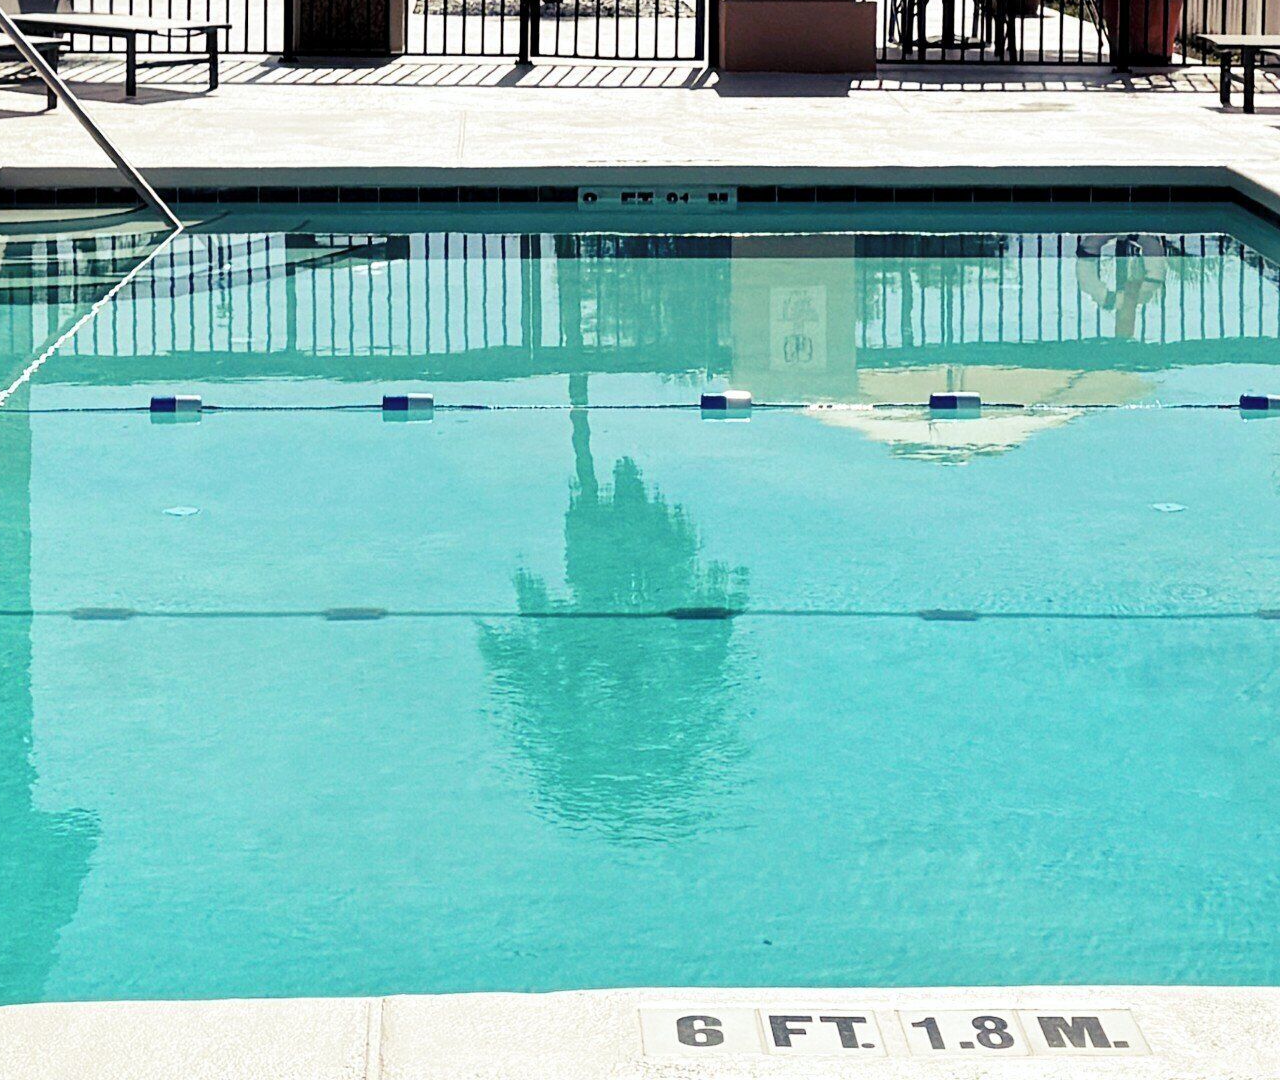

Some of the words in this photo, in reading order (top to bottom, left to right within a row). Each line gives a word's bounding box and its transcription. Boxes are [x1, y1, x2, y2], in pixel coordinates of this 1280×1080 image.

[677, 1015, 724, 1048] 6
[769, 1015, 875, 1049] FT.
[911, 1016, 1015, 1050] 1.8
[1037, 1016, 1130, 1049] M.
